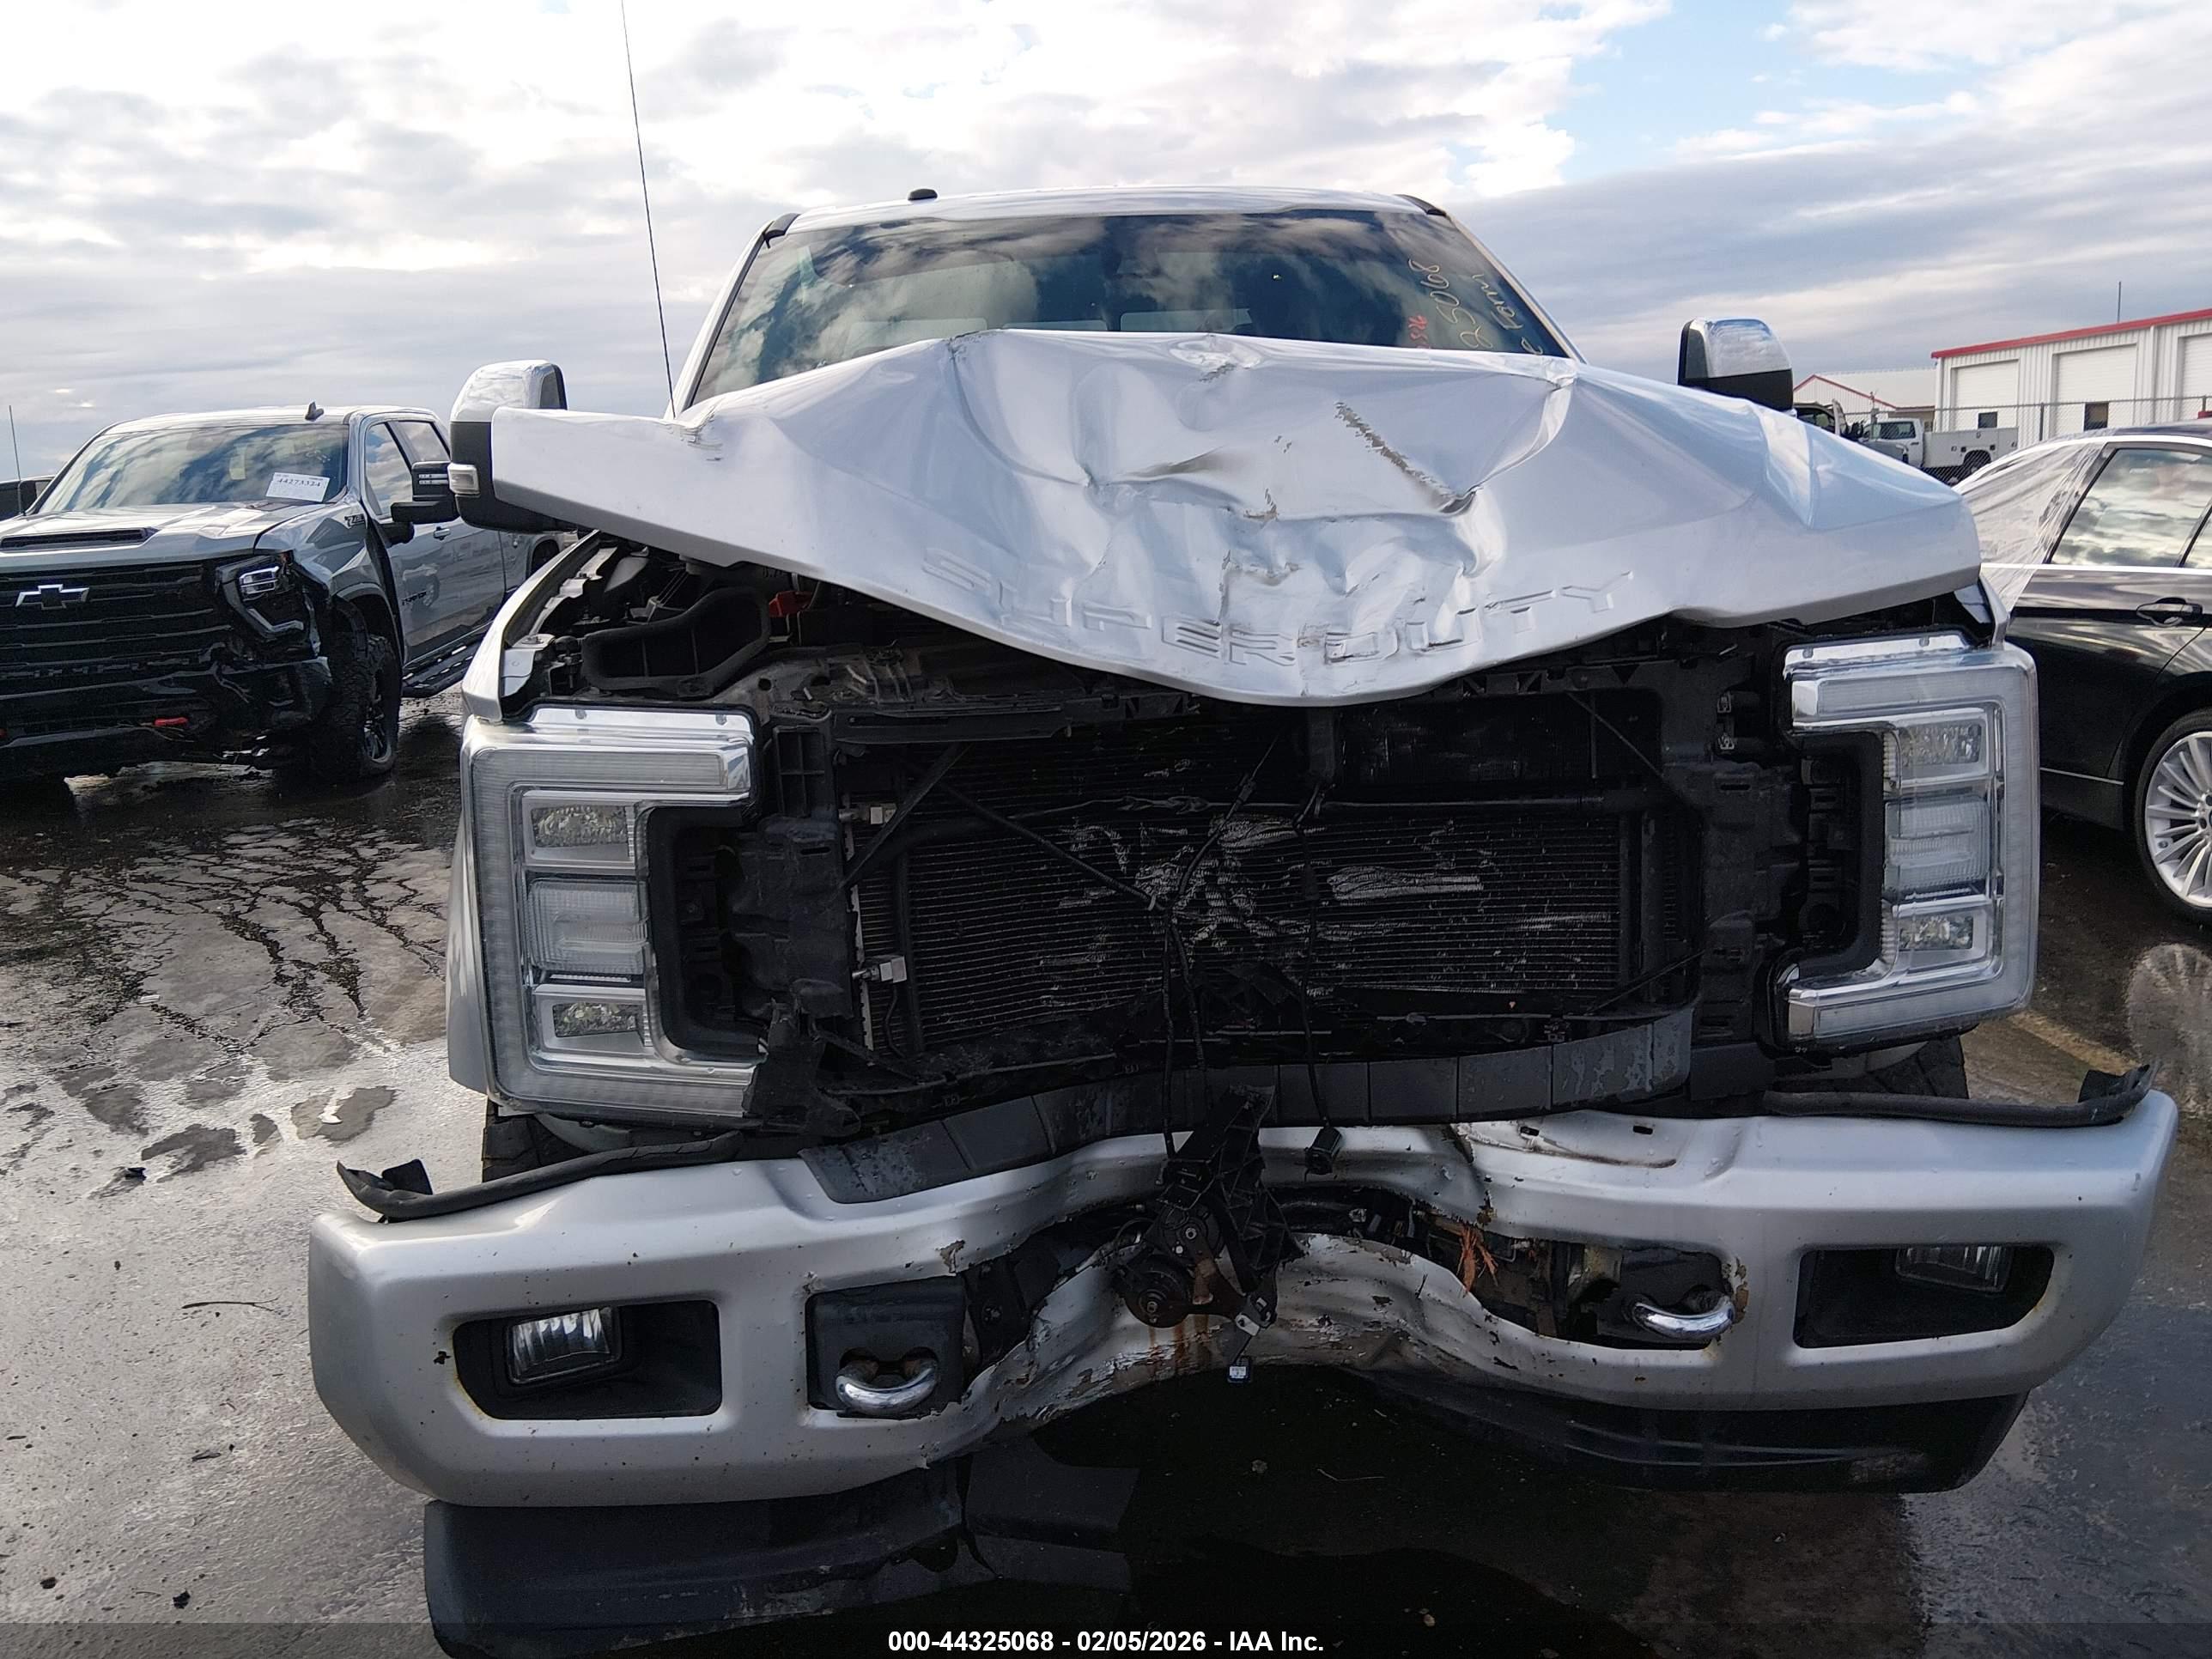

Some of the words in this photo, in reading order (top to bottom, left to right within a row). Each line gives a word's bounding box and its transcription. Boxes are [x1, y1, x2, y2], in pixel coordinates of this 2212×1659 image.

[1408, 258, 1493, 349] 25068
[921, 547, 1297, 666] SUPER
[1324, 570, 1634, 665] DUTY
